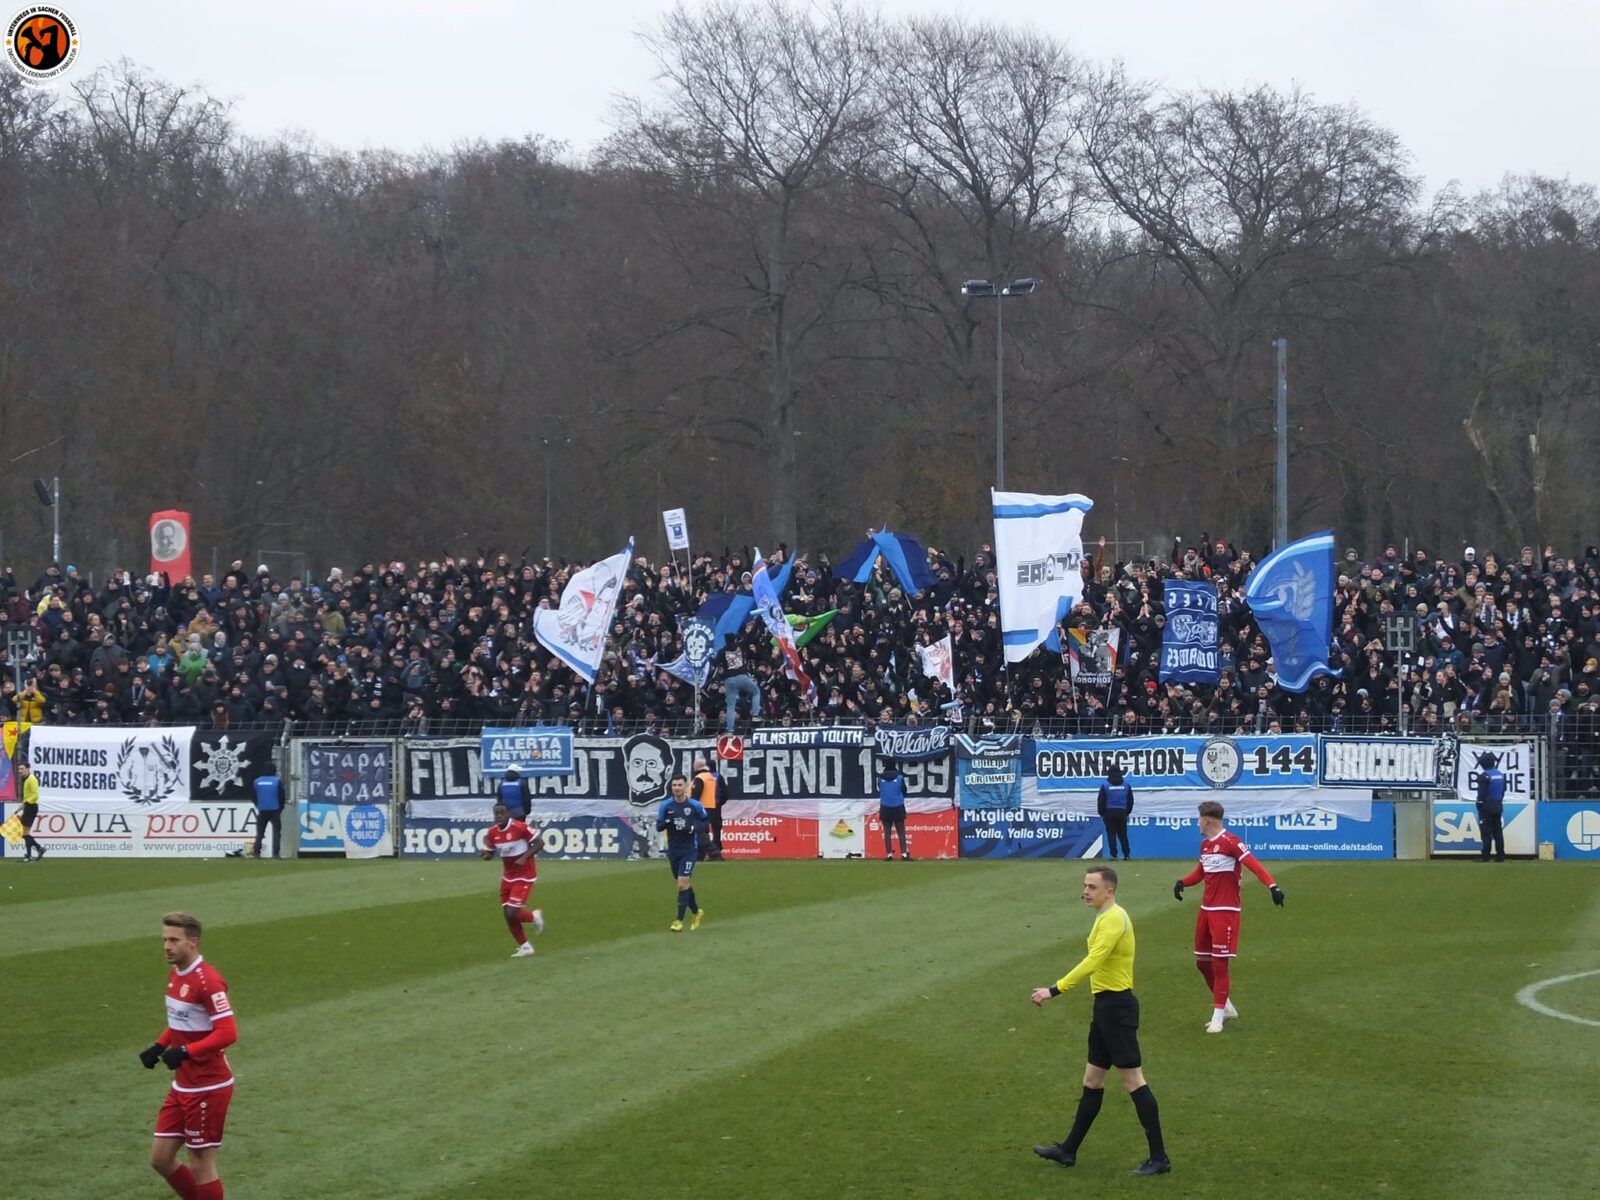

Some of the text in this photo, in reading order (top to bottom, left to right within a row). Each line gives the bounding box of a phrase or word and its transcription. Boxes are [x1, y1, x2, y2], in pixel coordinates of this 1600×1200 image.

[491, 737, 562, 750] ALERTA
[753, 730, 863, 745] FILMSTADT YOUTH
[34, 746, 107, 767] SKINHEADS
[1037, 746, 1315, 779] CONNECTION 144
[32, 807, 260, 838] roVIA proVIA
[963, 809, 1024, 825] Mitglied
[1155, 815, 1191, 829] Liga
[301, 811, 344, 840] SA
[1435, 811, 1483, 843] SA
[351, 831, 380, 840] POLICE
[1007, 828, 1034, 839] Yalla
[1036, 828, 1063, 839] SVB!
[1269, 843, 1383, 851] www.maz-online.de/stadion
